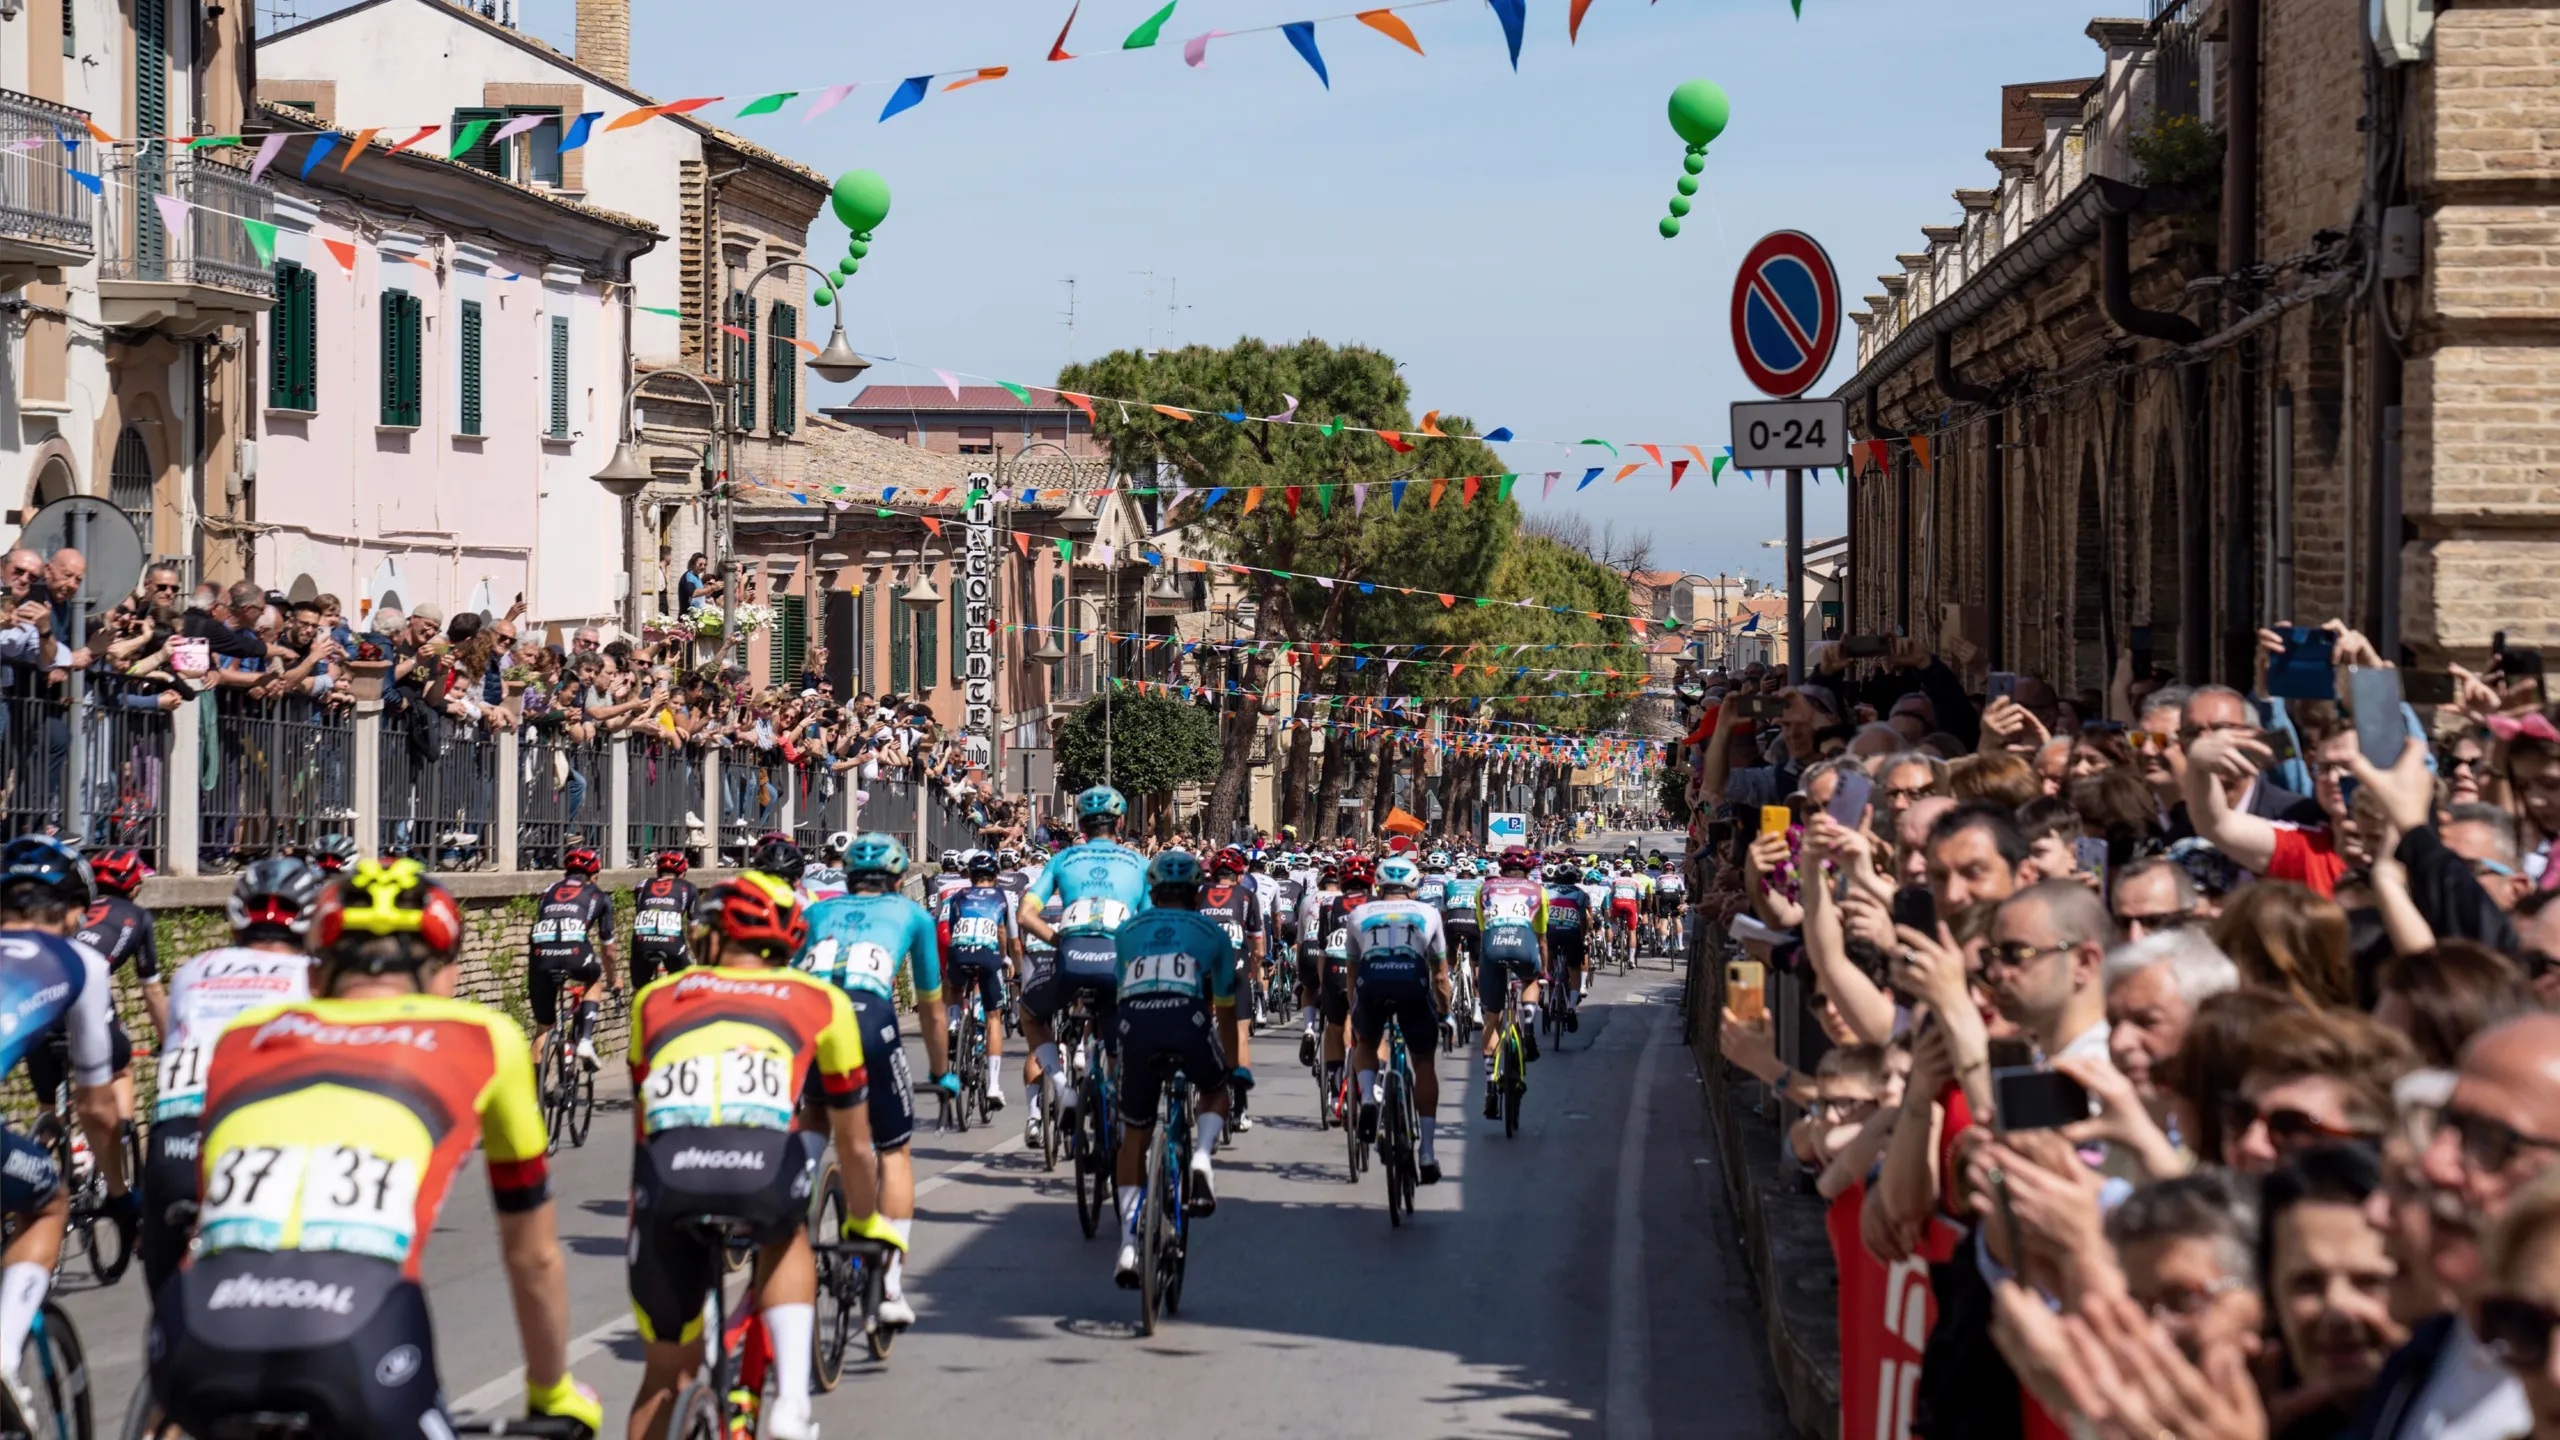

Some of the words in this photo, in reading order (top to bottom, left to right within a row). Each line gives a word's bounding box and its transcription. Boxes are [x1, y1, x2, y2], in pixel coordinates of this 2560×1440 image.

[1749, 419, 1826, 450] 0-24
[544, 903, 579, 913] TUDOR
[645, 897, 675, 906] TUDOR
[1512, 902, 1527, 917] 43
[636, 911, 655, 926] 164
[659, 912, 681, 927] 164
[1068, 904, 1077, 923] 4
[1200, 908, 1234, 916] TUDOR
[1548, 906, 1561, 919] 23
[1564, 908, 1580, 921] 123
[533, 919, 557, 933] 162
[954, 919, 969, 935] 86
[982, 919, 997, 937] 86
[1328, 930, 1345, 947] 16
[1492, 934, 1522, 946] italia
[540, 948, 573, 956] TUDOR
[868, 948, 883, 971] 5
[1134, 956, 1146, 979] 6
[1173, 953, 1186, 978] 6
[167, 1046, 200, 1089] 71
[655, 1057, 700, 1098] 36
[737, 1053, 780, 1097] 36
[671, 1146, 766, 1171] BINGOAL
[209, 1146, 284, 1207] 37
[331, 1146, 395, 1210] 37
[206, 1271, 355, 1315] BINGOAL
